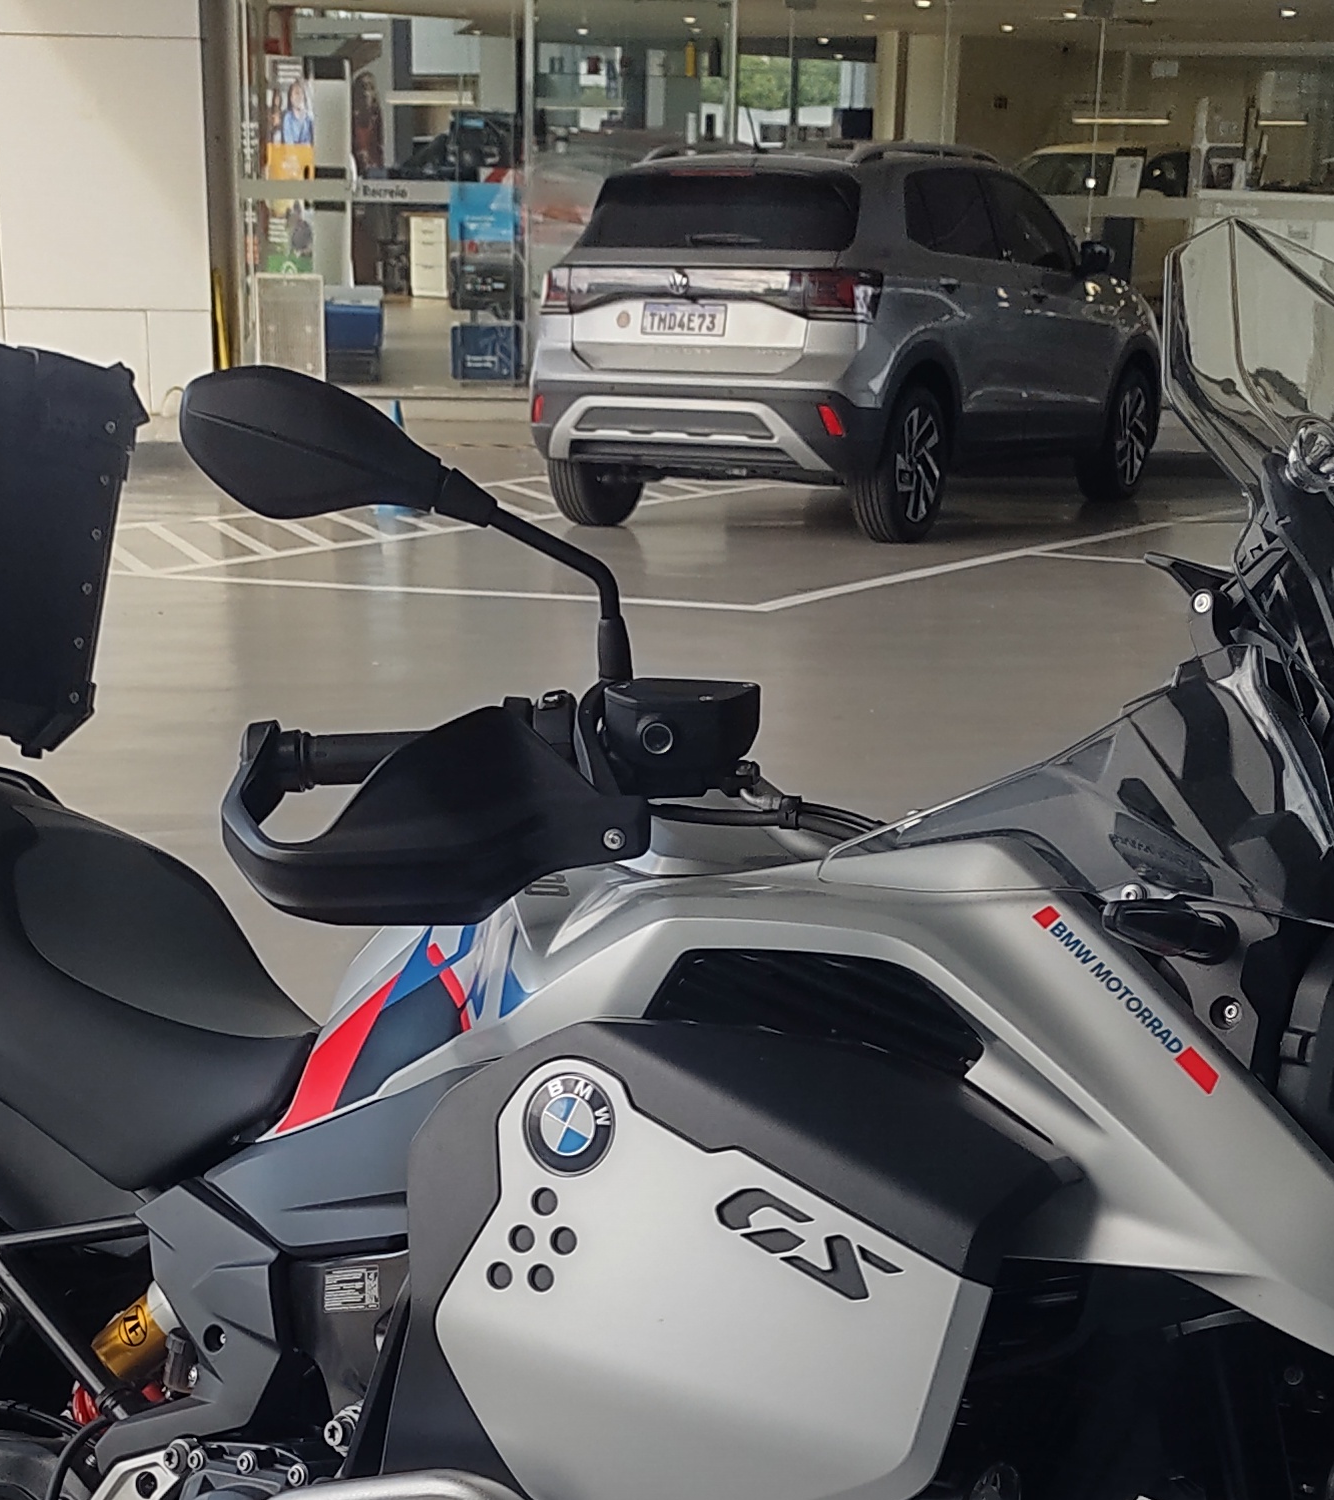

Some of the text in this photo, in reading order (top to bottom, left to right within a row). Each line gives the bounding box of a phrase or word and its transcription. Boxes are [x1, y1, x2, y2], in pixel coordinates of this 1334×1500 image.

[648, 311, 718, 333] TMD4E73
[1048, 919, 1098, 966] BMW
[1088, 960, 1186, 1056] MOTORRAD
[547, 1077, 612, 1127] BMW
[715, 1186, 905, 1302] GS
